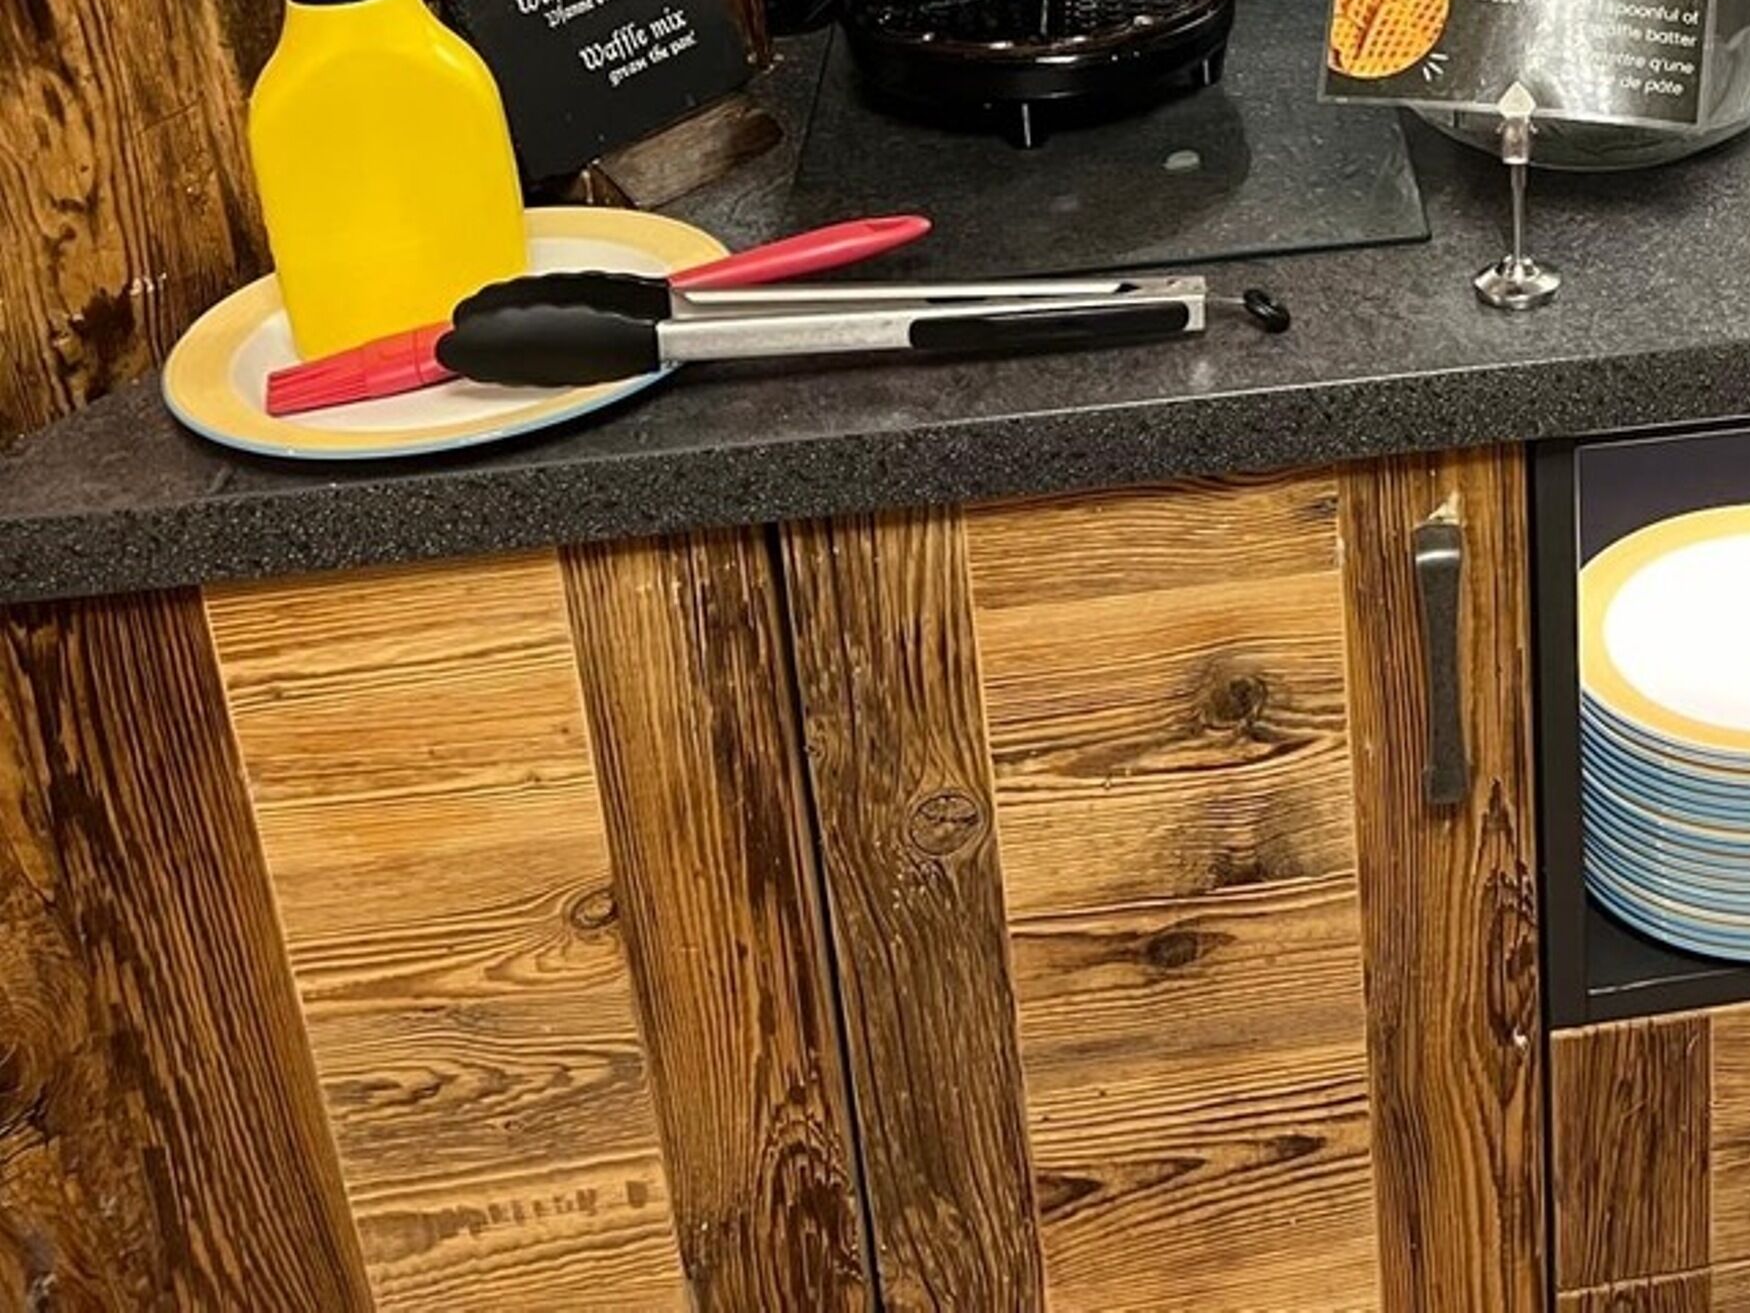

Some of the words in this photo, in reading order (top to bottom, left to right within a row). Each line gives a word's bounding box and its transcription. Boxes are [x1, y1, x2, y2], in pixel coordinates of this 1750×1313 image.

[1682, 9, 1699, 25] of
[578, 21, 649, 71] Waffle
[648, 6, 687, 39] mix
[1645, 28, 1697, 47] batter
